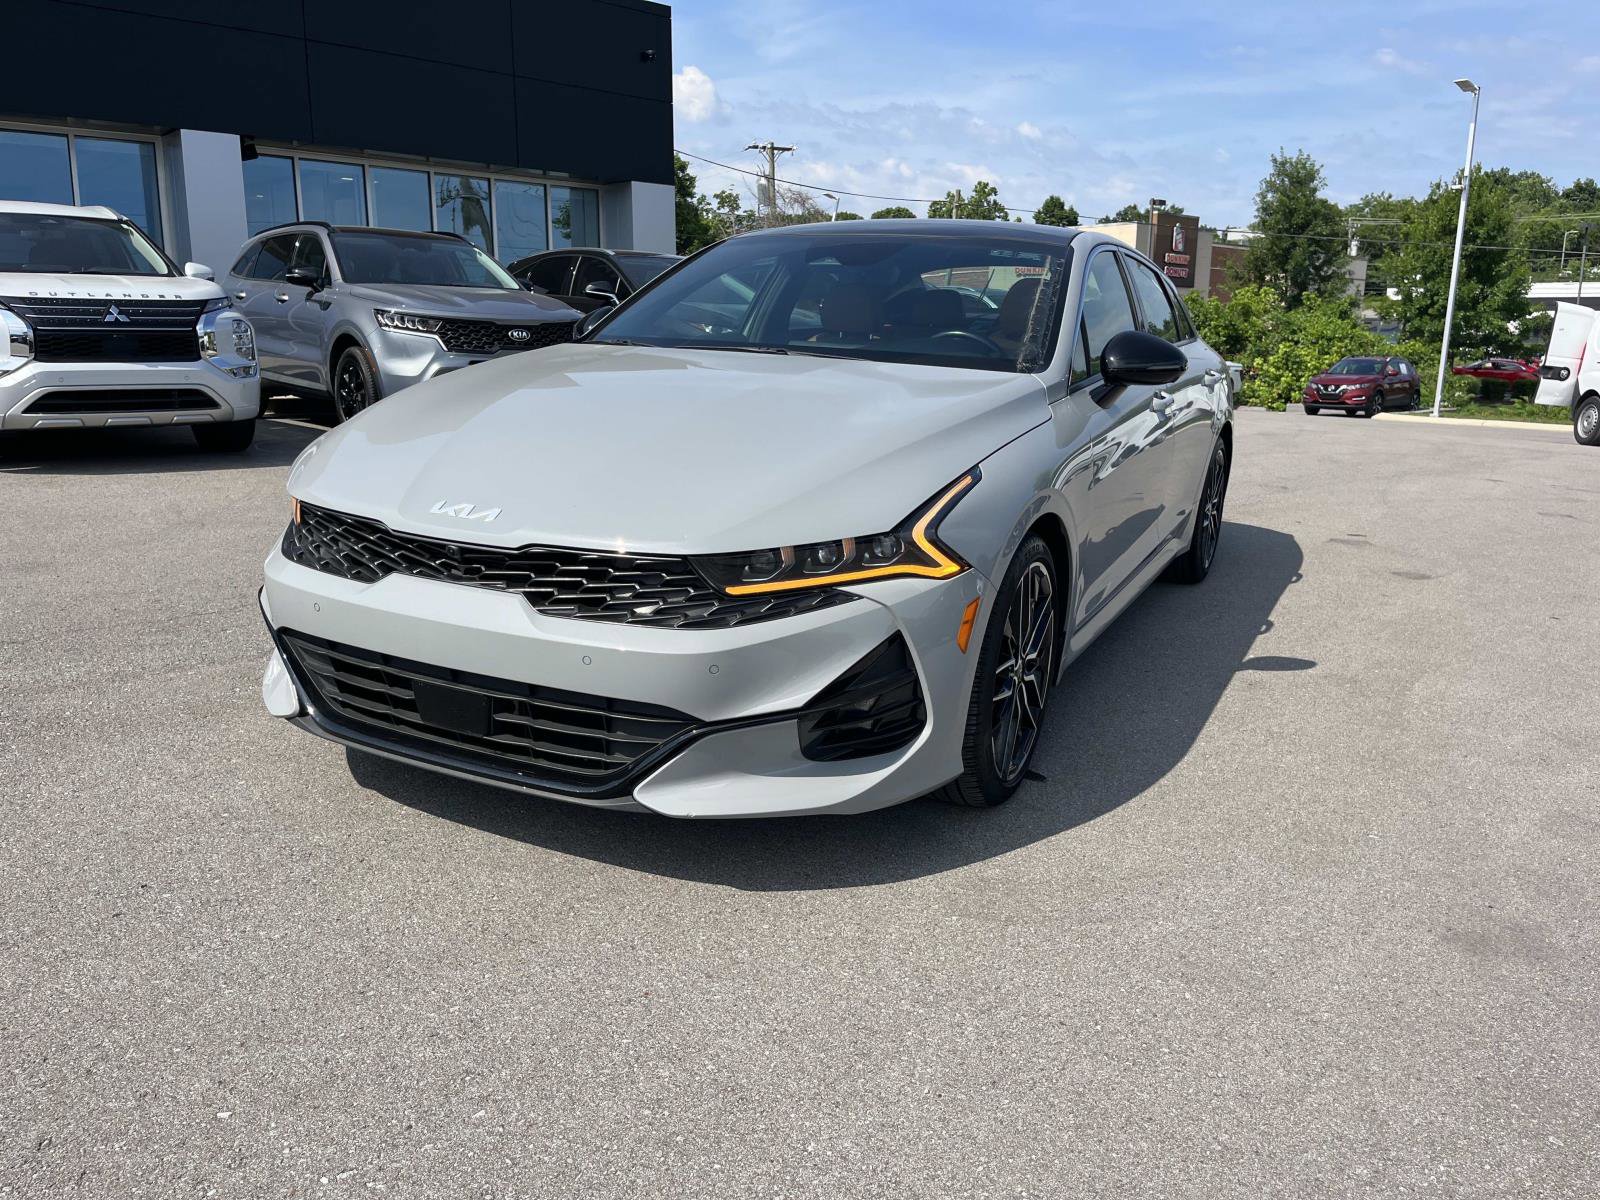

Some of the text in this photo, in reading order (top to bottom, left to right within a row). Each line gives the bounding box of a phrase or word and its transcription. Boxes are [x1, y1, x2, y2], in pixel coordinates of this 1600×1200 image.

[1164, 266, 1189, 278] DONUTS
[29, 291, 182, 299] OUTLANDER
[512, 331, 528, 339] KIA
[430, 500, 502, 521] KIA
